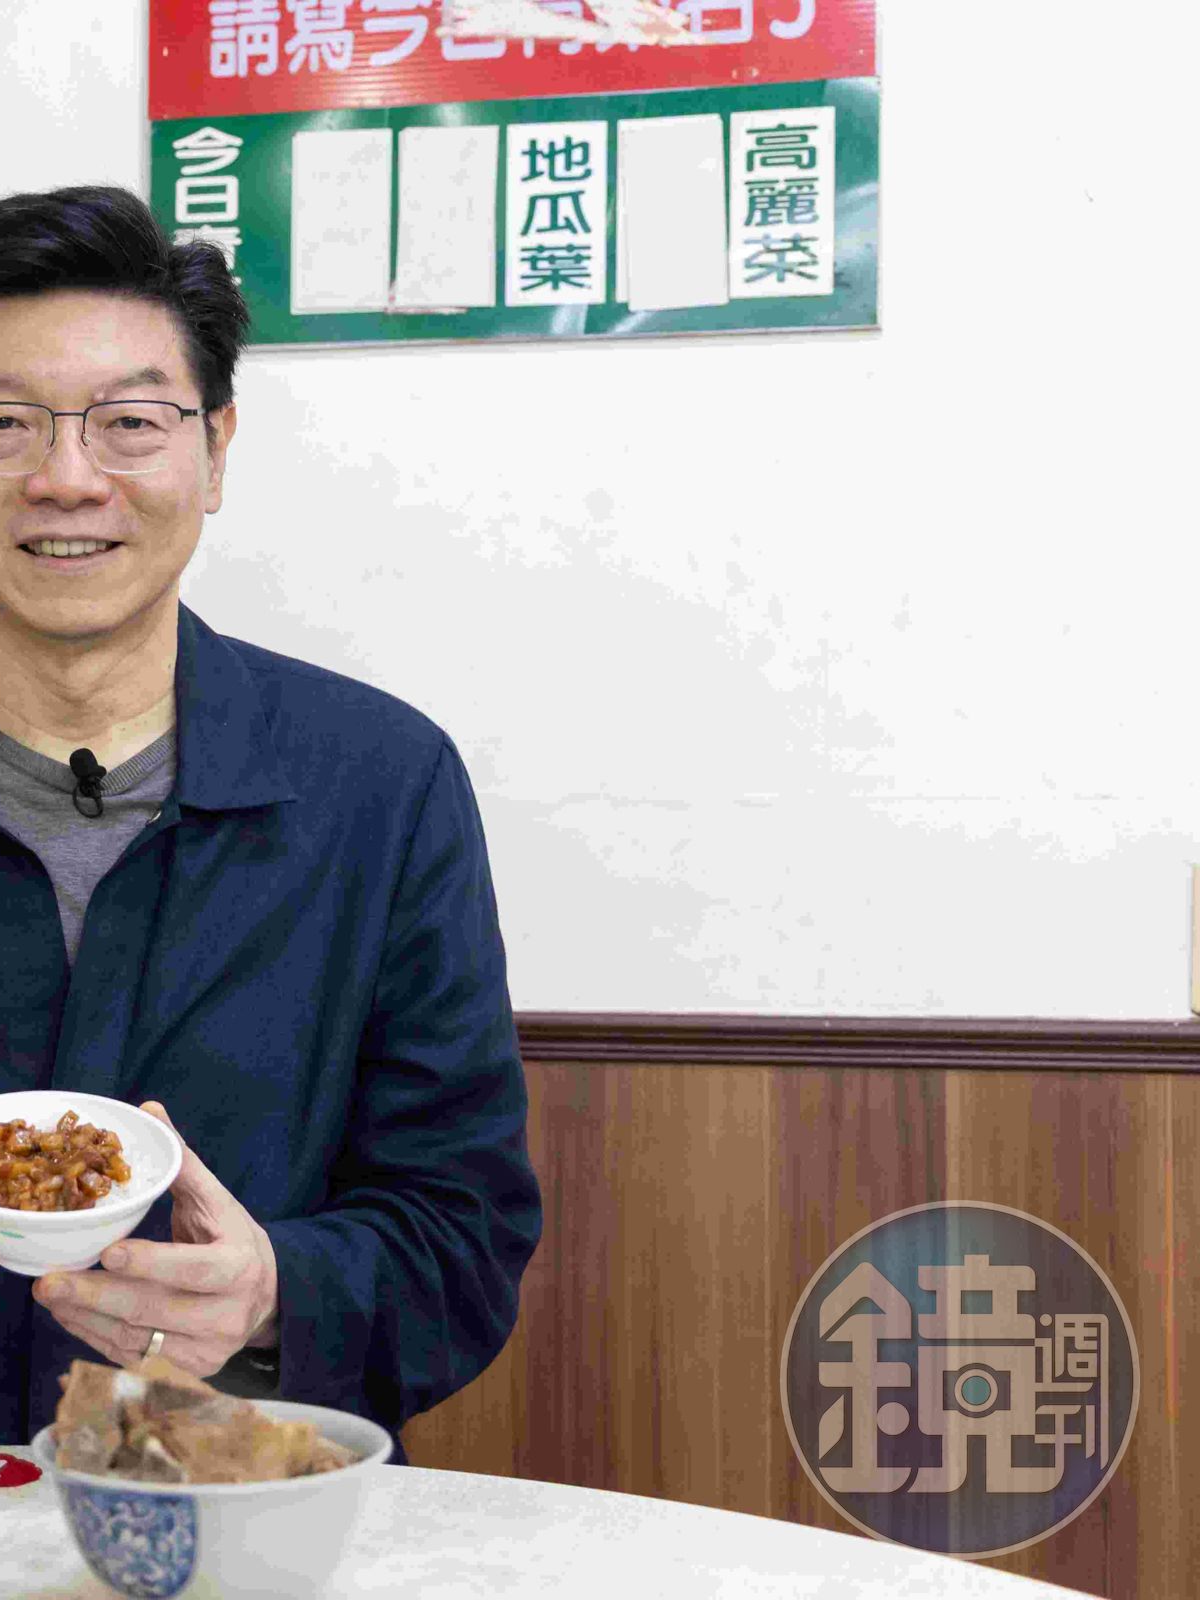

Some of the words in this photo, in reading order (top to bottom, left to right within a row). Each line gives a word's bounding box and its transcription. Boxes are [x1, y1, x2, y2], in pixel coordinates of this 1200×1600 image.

[520, 135, 592, 292] 地瓜葉
[743, 123, 819, 284] 高麗菜
